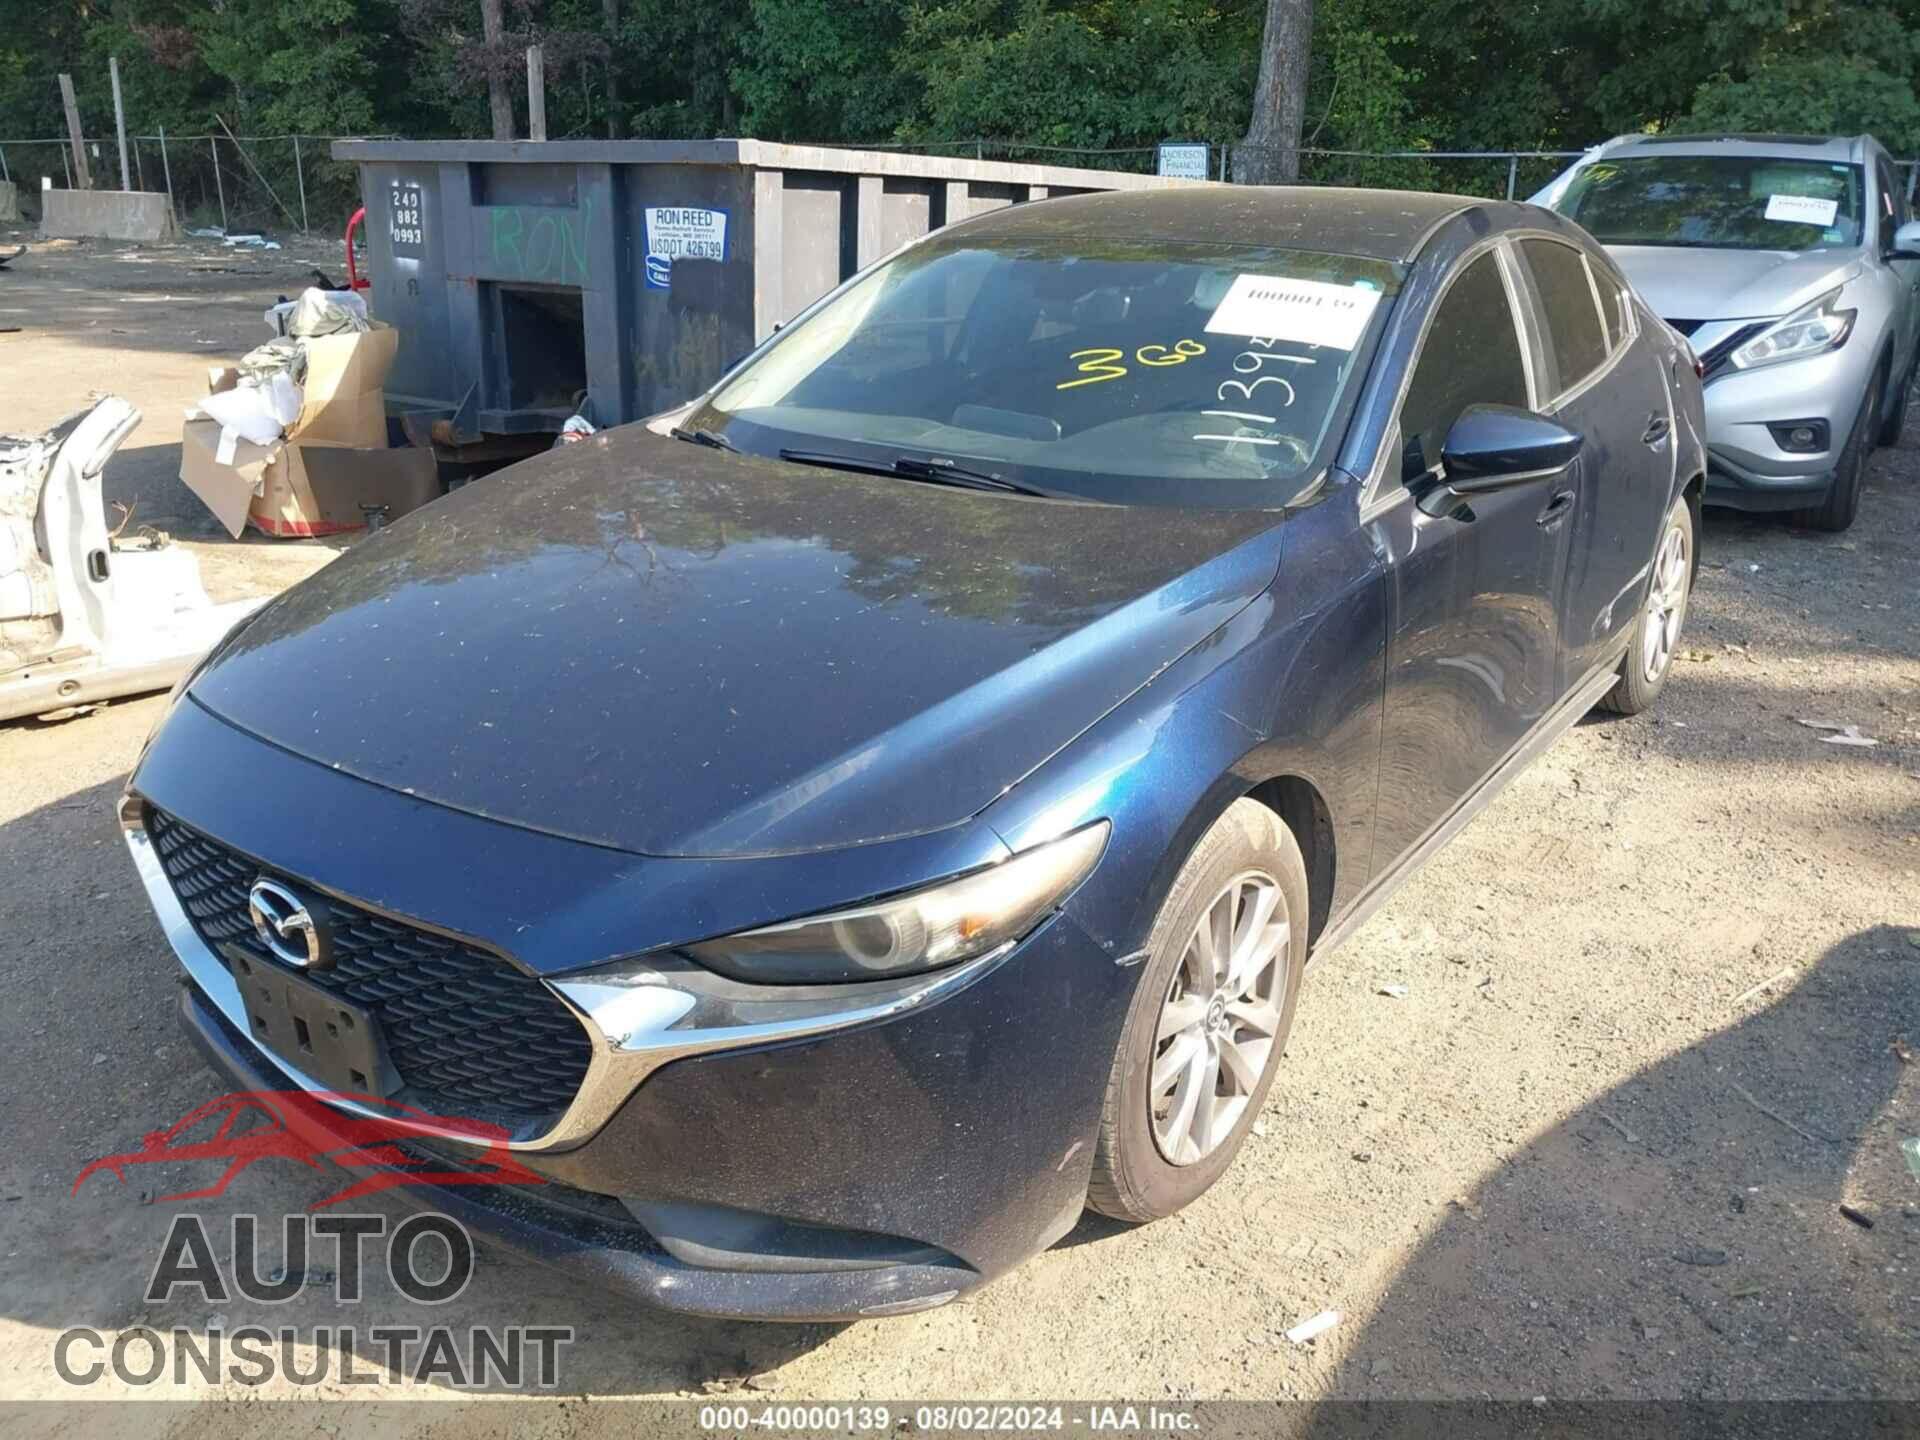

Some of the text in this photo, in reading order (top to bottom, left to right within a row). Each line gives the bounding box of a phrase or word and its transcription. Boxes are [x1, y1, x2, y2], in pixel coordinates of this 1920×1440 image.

[393, 191, 418, 207] 240
[397, 209, 418, 225] 882
[656, 209, 713, 226] RON REED
[394, 228, 421, 243] 0993
[491, 197, 592, 285] RON
[651, 239, 721, 257] USDOT 426799
